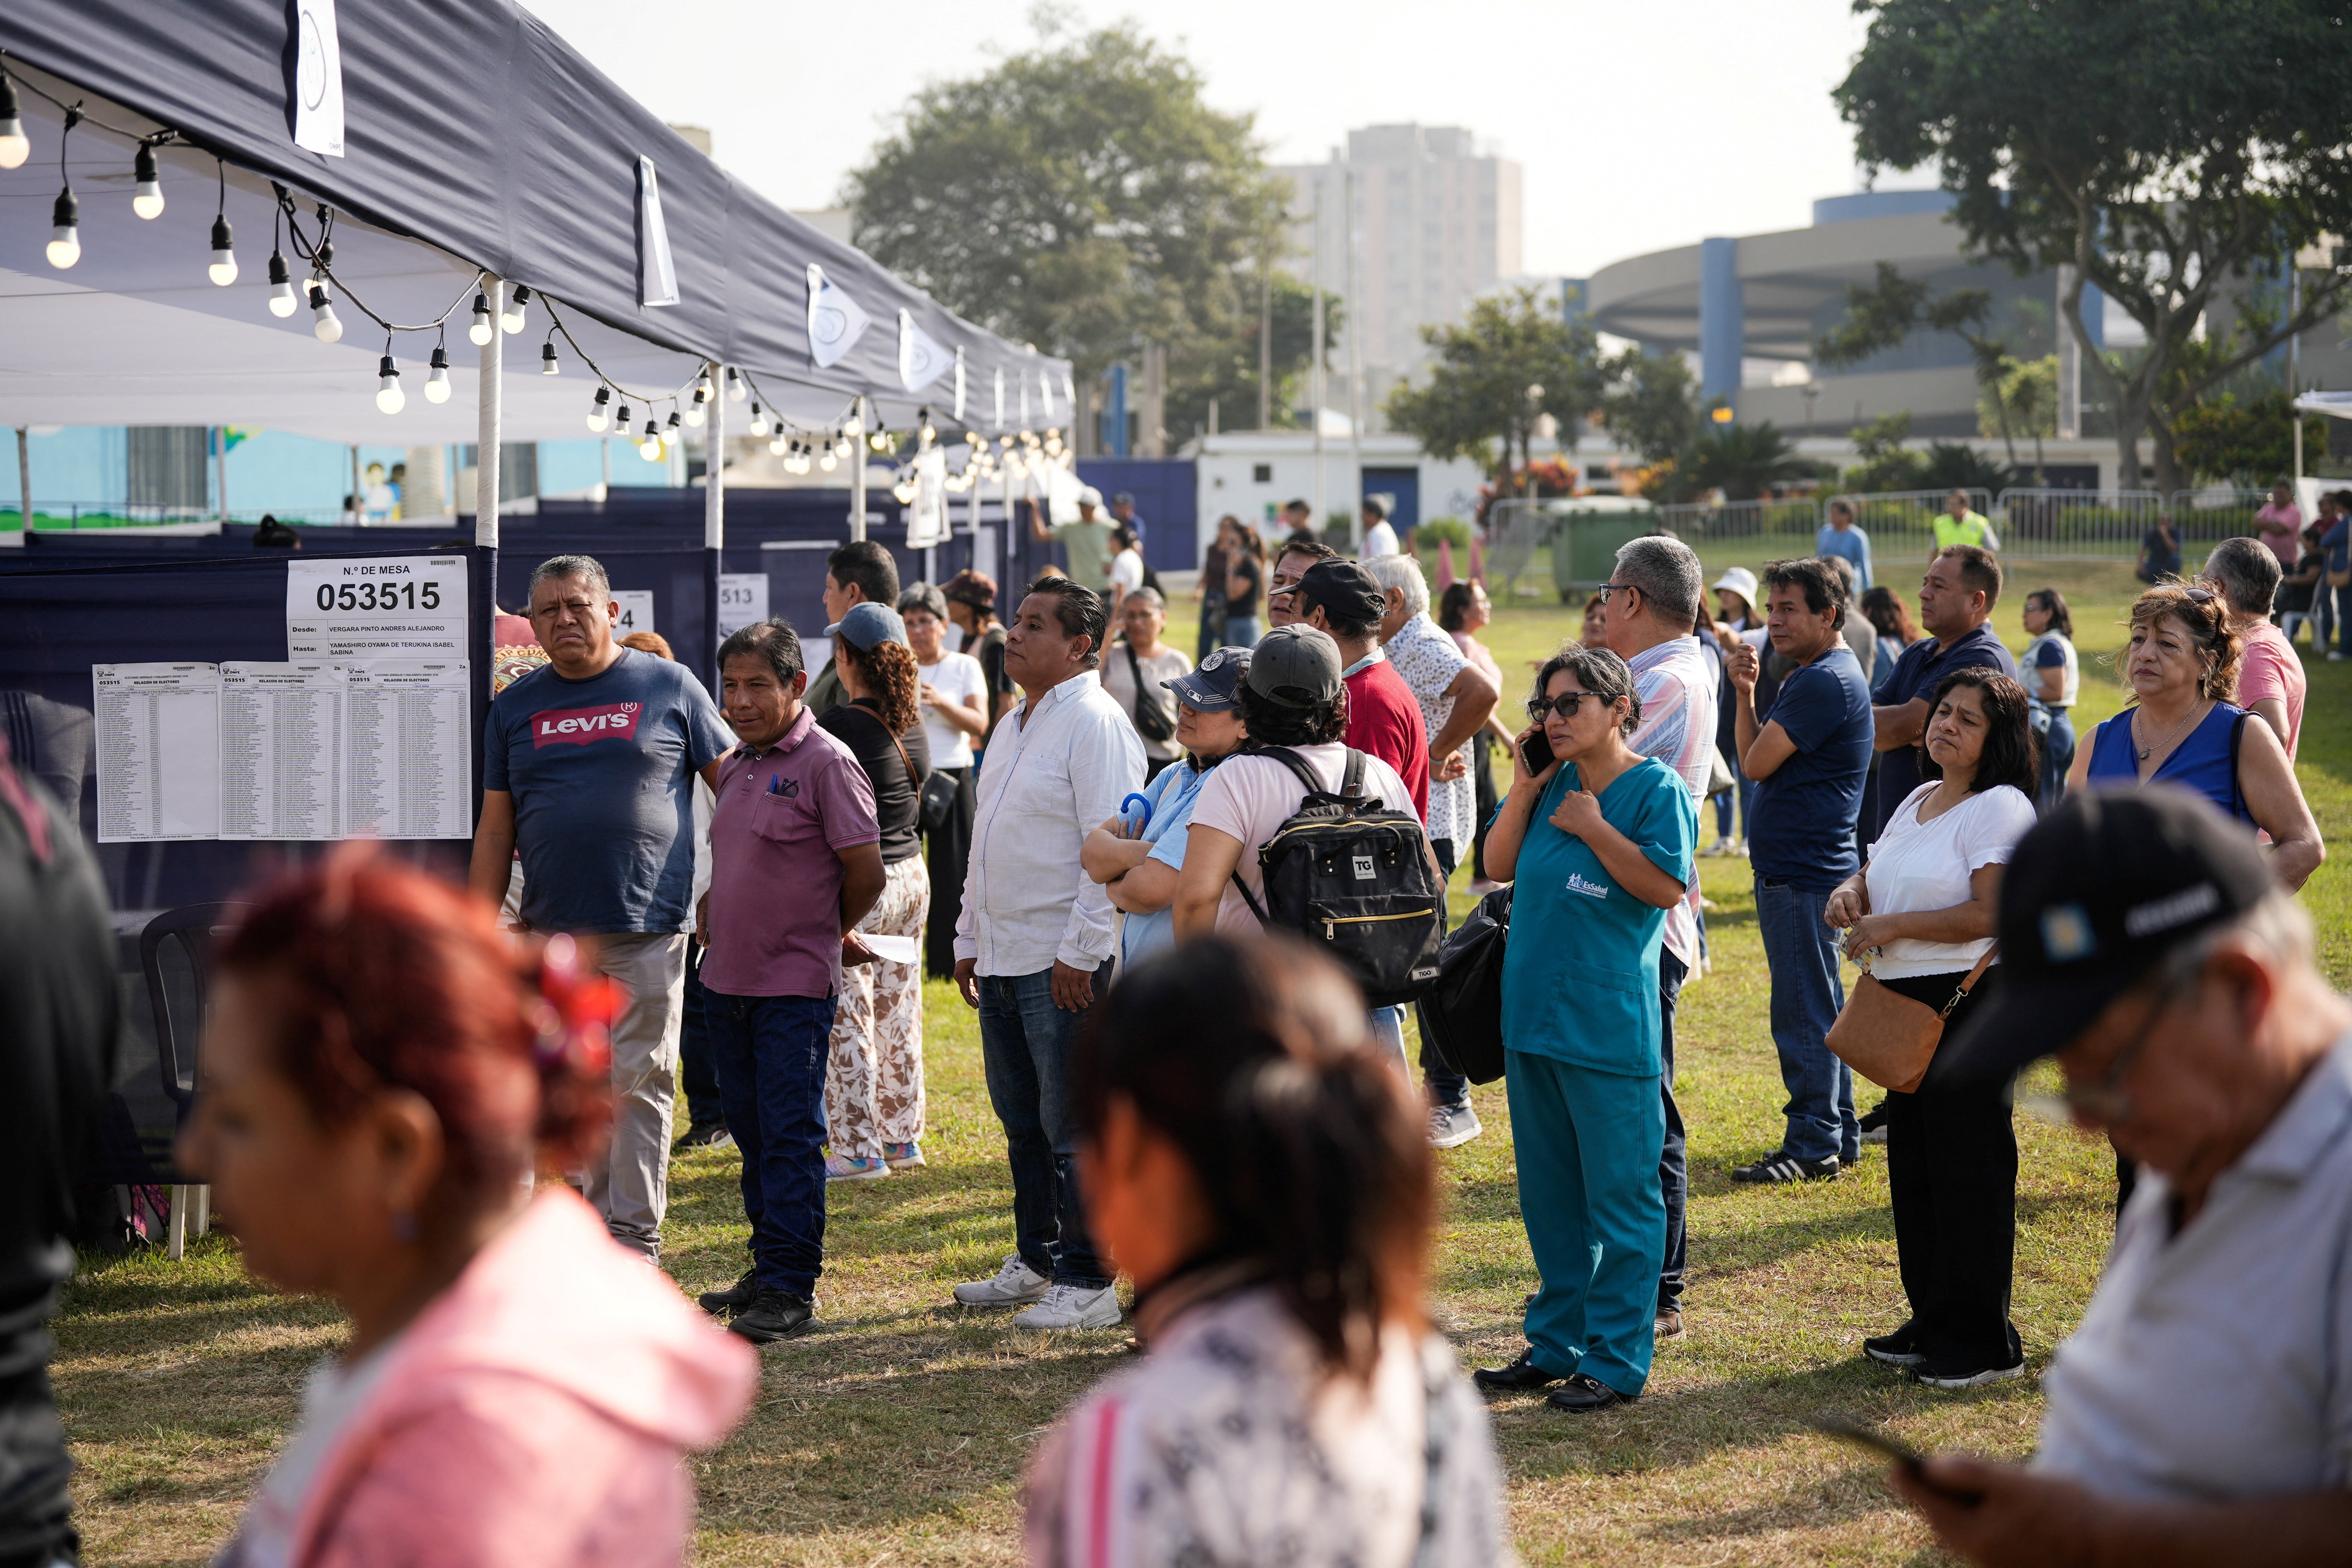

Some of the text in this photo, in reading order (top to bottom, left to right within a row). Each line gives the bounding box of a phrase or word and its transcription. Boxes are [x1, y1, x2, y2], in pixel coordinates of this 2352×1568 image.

[361, 567, 375, 575] DE
[379, 566, 410, 574] MESA
[317, 582, 440, 610] 053515
[613, 609, 633, 628] 4
[1355, 861, 1371, 871] TG
[1583, 881, 1608, 894] EsSalud
